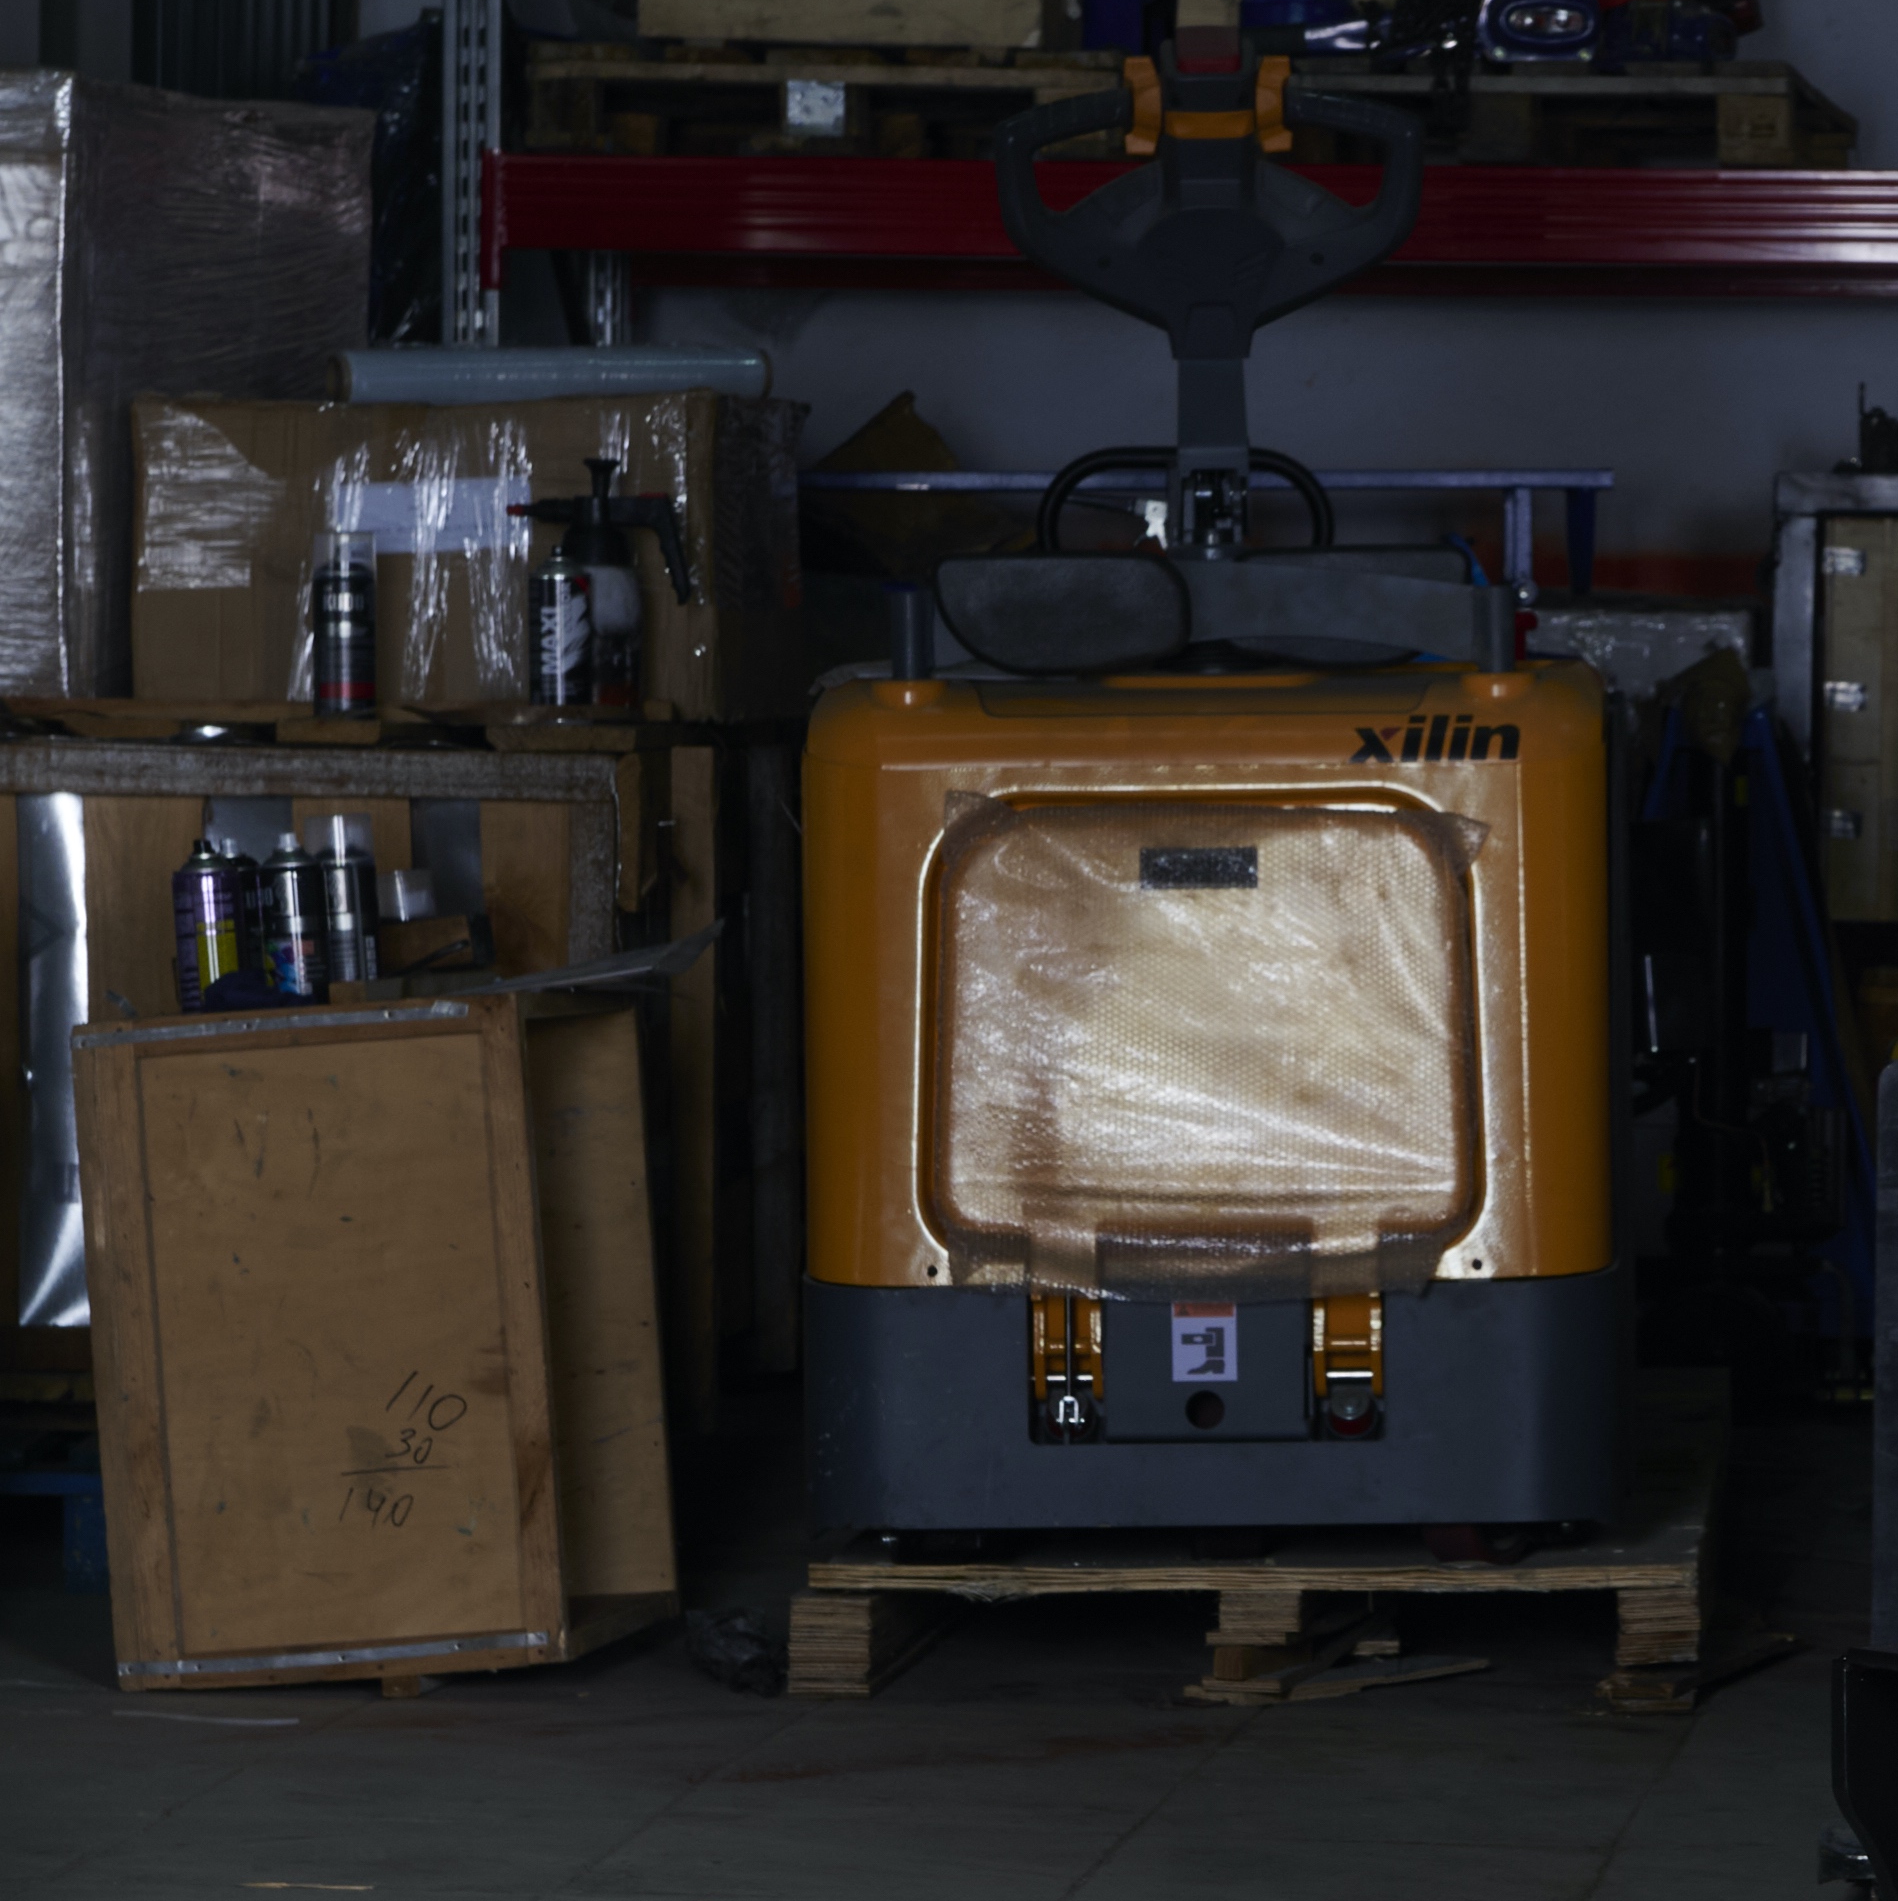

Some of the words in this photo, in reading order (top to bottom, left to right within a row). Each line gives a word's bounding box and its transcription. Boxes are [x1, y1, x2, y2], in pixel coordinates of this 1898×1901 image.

[1349, 715, 1520, 763] xilin
[386, 1371, 467, 1431] 110
[385, 1428, 433, 1464] 30
